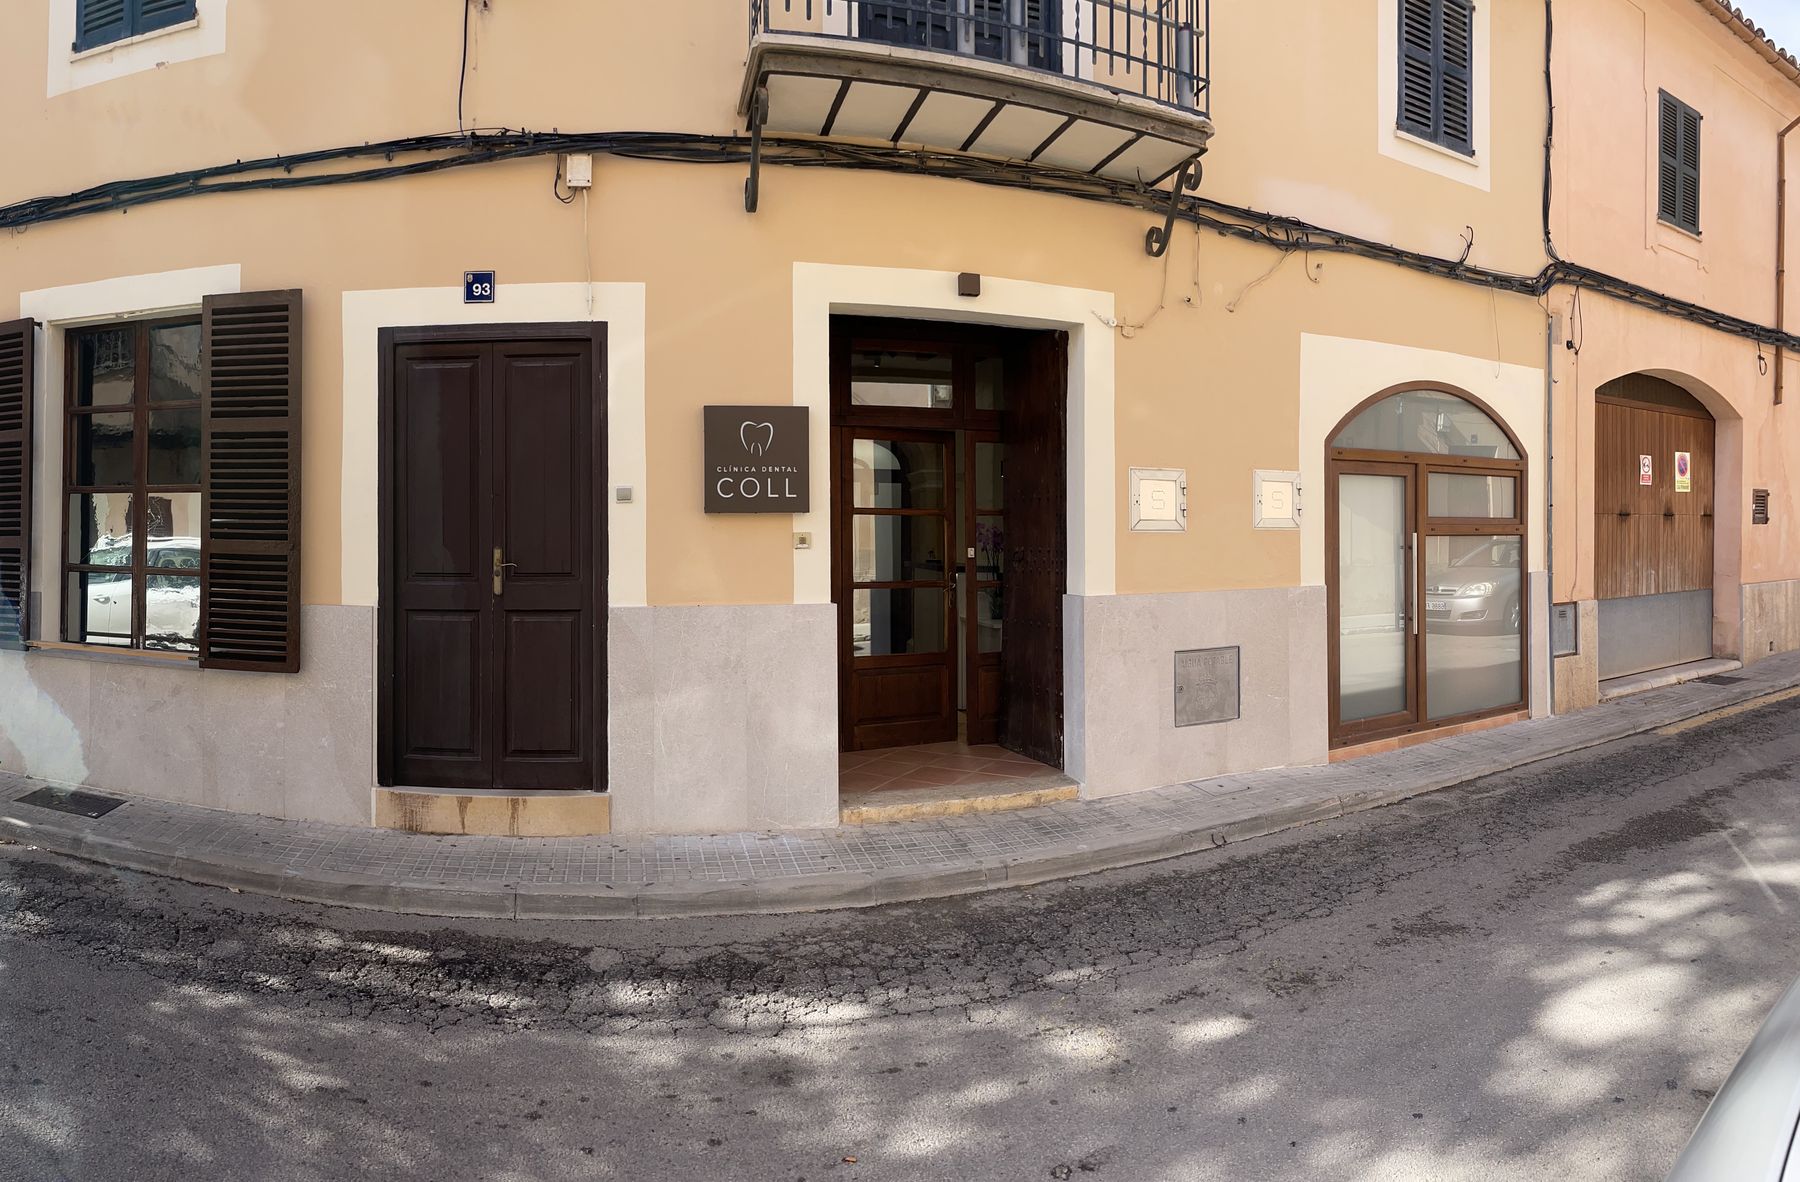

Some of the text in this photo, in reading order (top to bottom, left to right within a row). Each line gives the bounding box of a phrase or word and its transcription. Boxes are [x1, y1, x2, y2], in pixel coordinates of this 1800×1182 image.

[472, 283, 491, 296] 93
[716, 465, 757, 473] CLÍNICA
[717, 477, 797, 498] COLL
